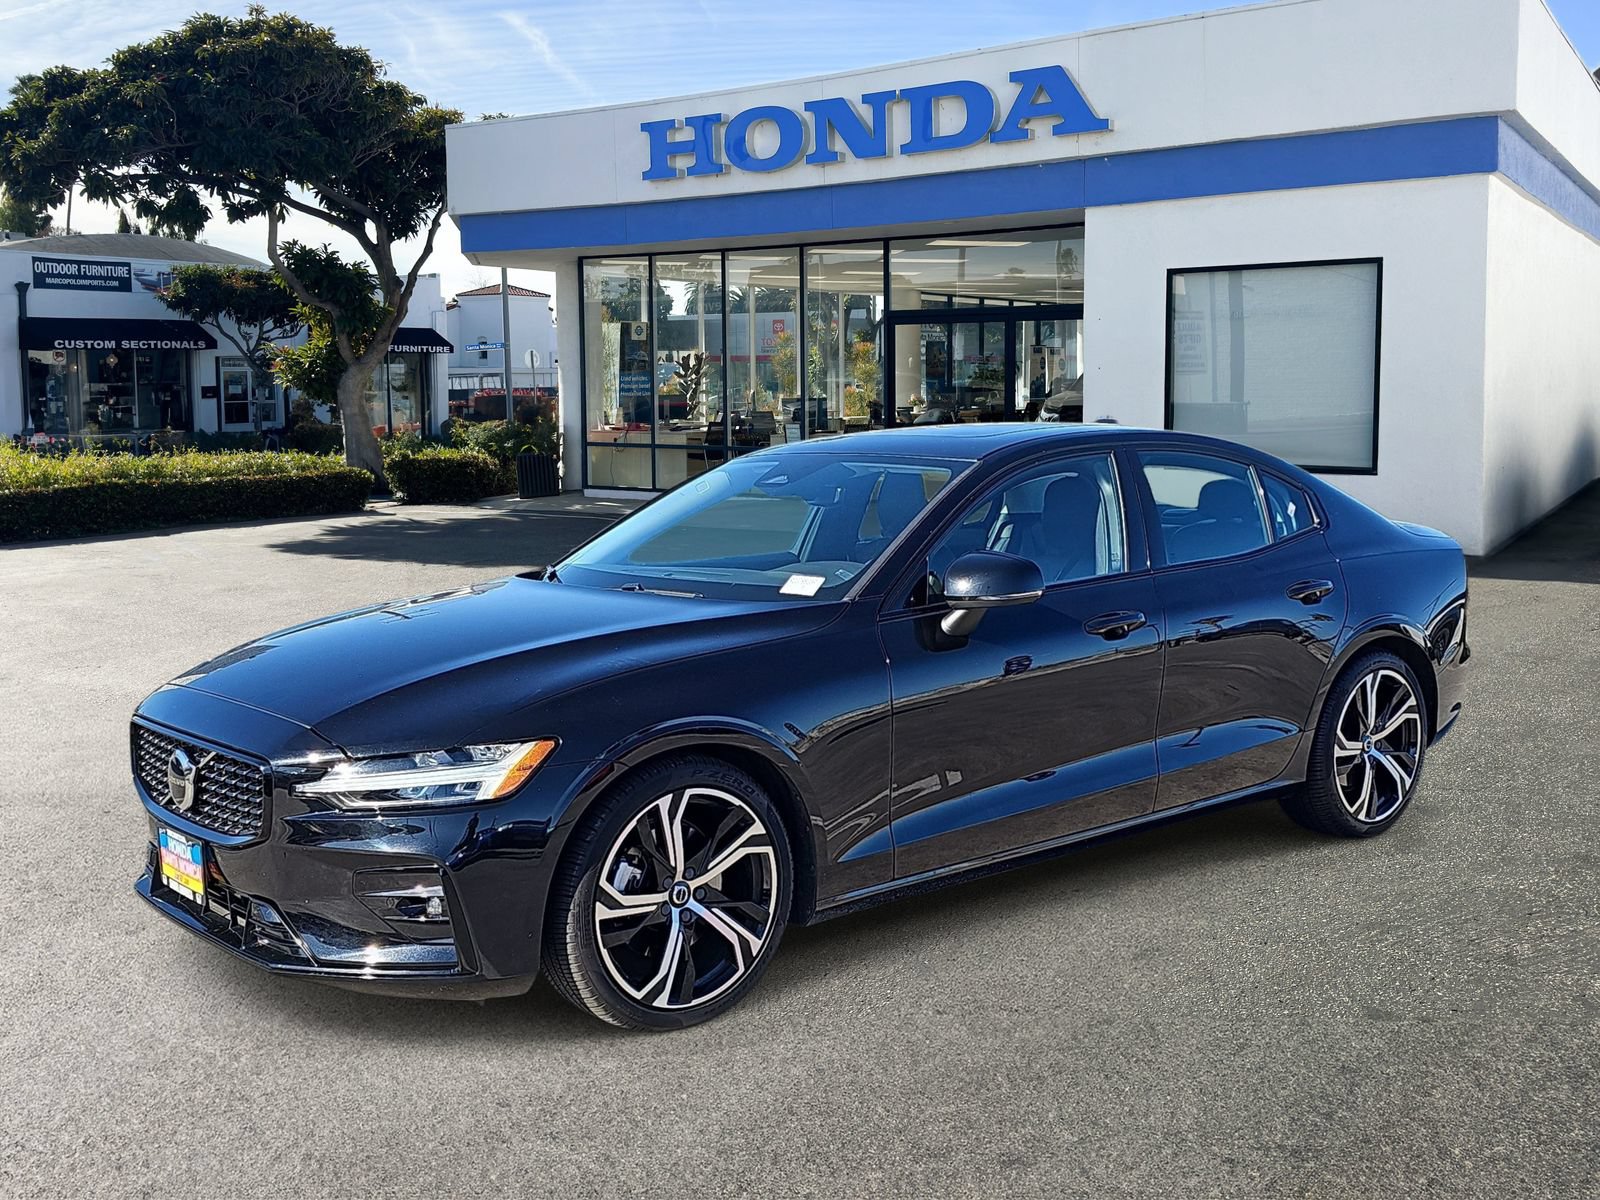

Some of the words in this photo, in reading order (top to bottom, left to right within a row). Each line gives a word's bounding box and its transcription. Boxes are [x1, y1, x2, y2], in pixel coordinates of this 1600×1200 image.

[640, 65, 1112, 181] HONDA
[34, 261, 79, 275] OUTDOOR
[80, 264, 130, 278] FURNITURE
[45, 277, 119, 287] MARCOPOLOIMPORTS.COM
[54, 340, 116, 349] CUSTOM
[121, 340, 206, 349] SECTIONALS
[388, 345, 450, 353] FURNITURE
